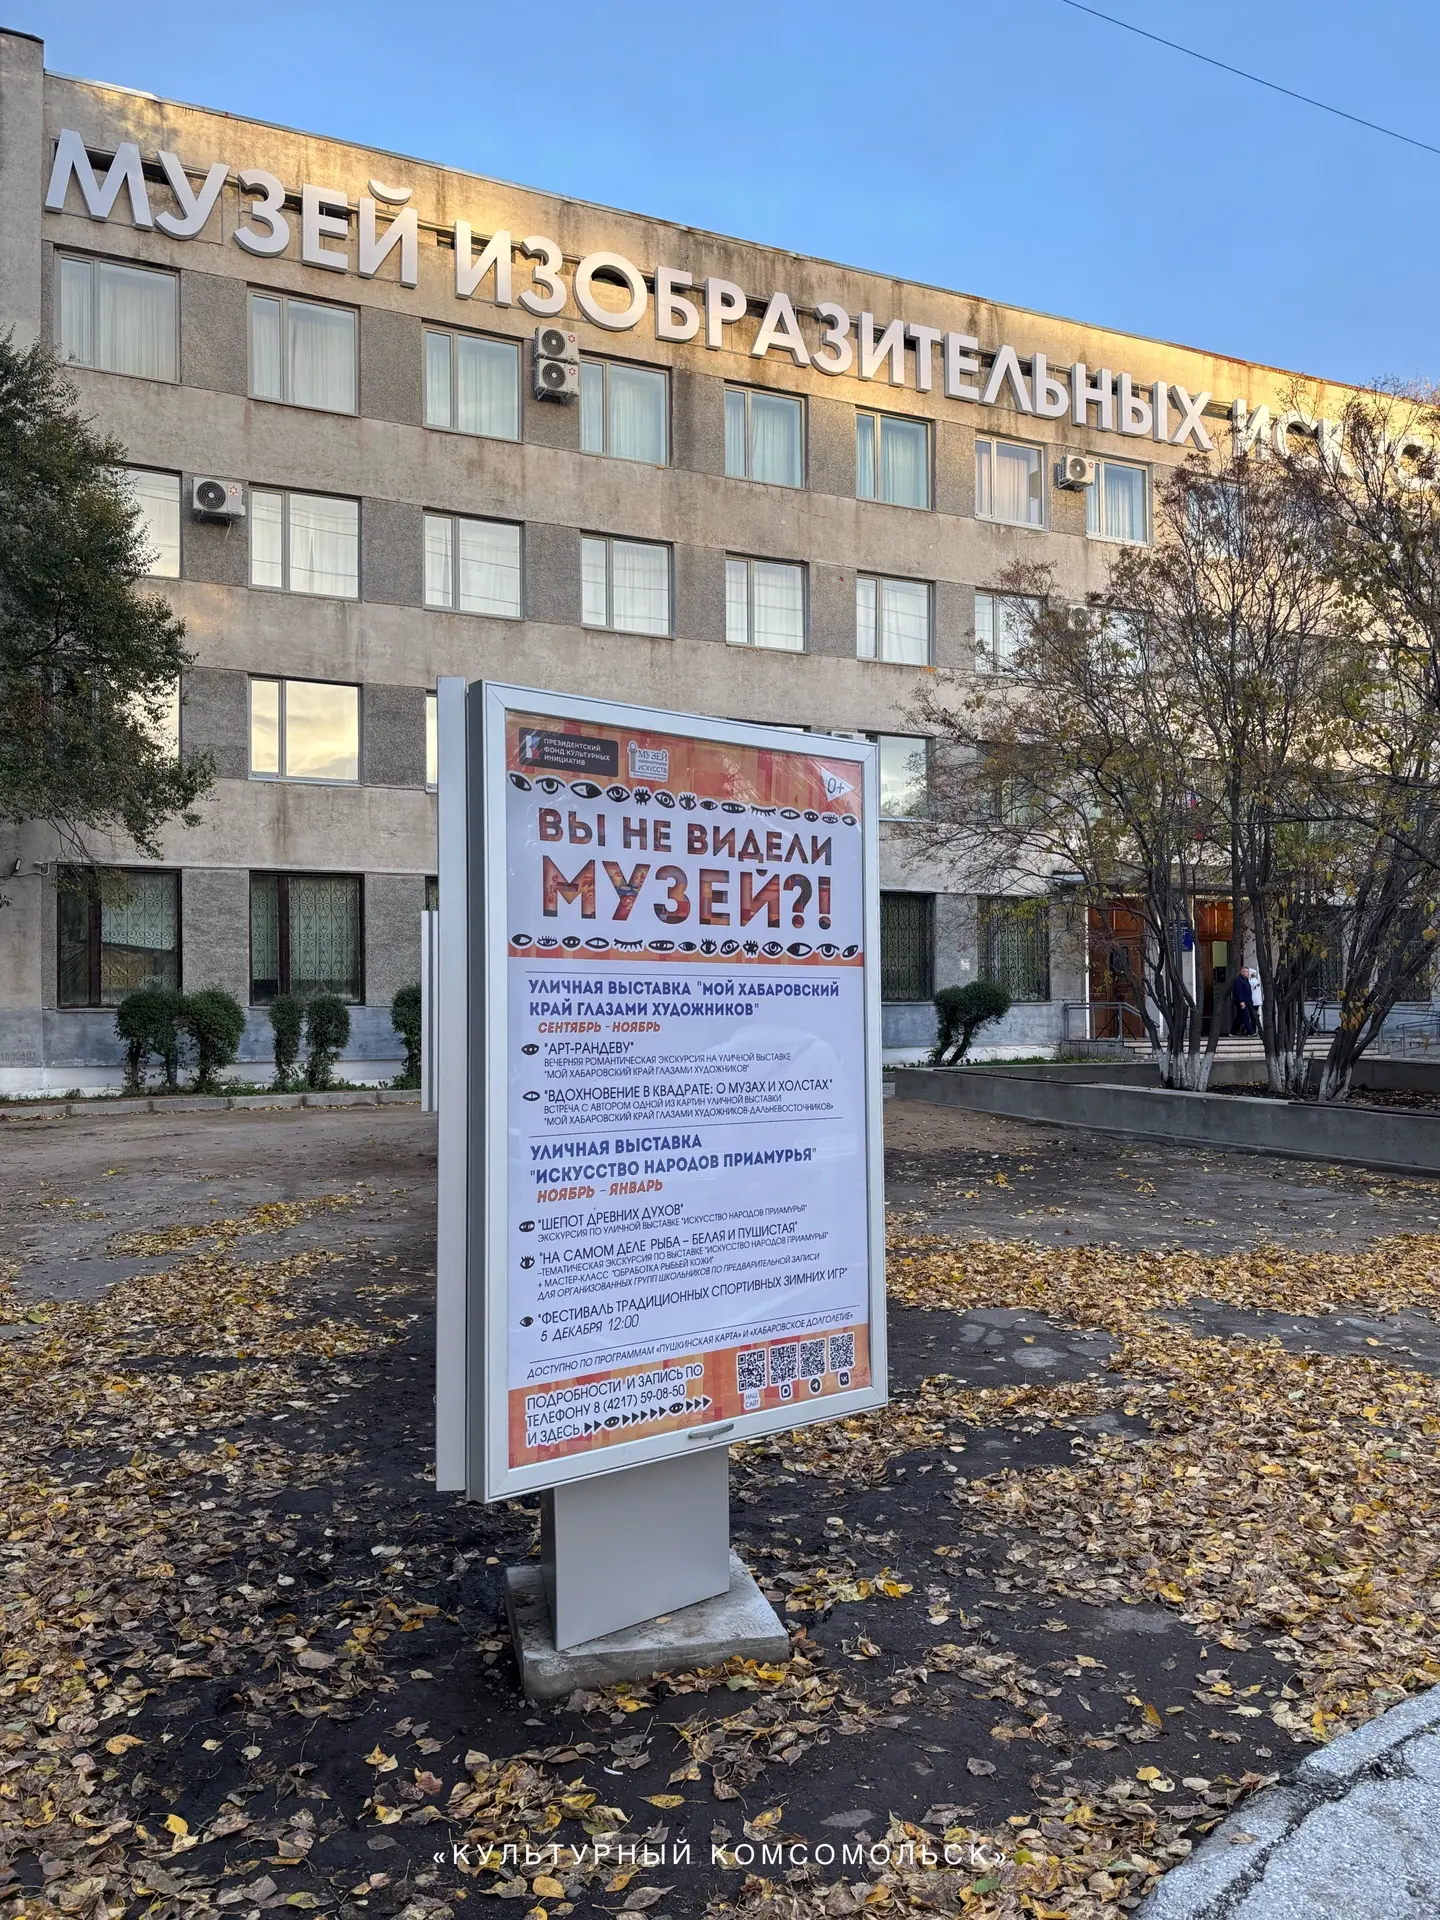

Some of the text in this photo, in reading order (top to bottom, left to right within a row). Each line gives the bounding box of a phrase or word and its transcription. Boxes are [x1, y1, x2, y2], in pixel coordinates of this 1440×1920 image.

[45, 128, 418, 289] МУЗЕЙ
[454, 220, 1213, 452] ИЗОБРАЗИТЕЛЬНЫХ
[544, 738, 601, 752] ПРЕЗИДЕНТСКИЙ
[544, 746, 610, 761] ФОНД КУЛЬТУРНЫХ
[638, 749, 668, 762] МУЗЕЙ
[544, 754, 586, 766] ИНИЦИАТИВ
[827, 777, 845, 794] 0+
[538, 807, 832, 865] ВЫ НЕ ВИДЕЛИ
[543, 855, 831, 930] МУЗЕЙ?!
[528, 979, 839, 997] УЛИЧНАЯ ВЫСТАВКА "МОЙ ХАБАРОВСКИЙ
[530, 998, 759, 1017] КРАЙ ГЛАЗАМИ ХУДОЖНИКОВ"
[538, 1022, 602, 1033] СЕНТЯБРЬ
[612, 1021, 661, 1032] НОЯБРЬ
[544, 1041, 634, 1056] "АРТ-РАНДЕВУ"
[544, 1052, 791, 1067] ВЕЧЕРНЯЯ РОМАНТИЧЕСКАЯ ЭКСКУРСИЯ НА УЛИЧНОЙ ВЫСТАВКЕ
[544, 1064, 749, 1078] "МОЙ ХАБАРОВСКИЙ КРАЙ ГЛАЗАМИ ХУДОЖНИКОВ"
[544, 1078, 833, 1103] "ВДОХНОВЕНИЕ В КВАДРАТЕ: О МУЗАХ И ХОЛСТАХ"
[544, 1094, 782, 1114] ВСТРЕЧА С АВТОРОМ ОДНОЙ ИЗ КАРТИН УЛИЧНОЙ ВЫСТАВКИ
[544, 1102, 834, 1126] "МОЙ ХАБАРОВСКИЙ КРАЙ ГЛАЗАМИ ХУДОЖНИКОВ-ДАЛЬНЕВОСТОЧНИКОВ»
[530, 1134, 702, 1160] УЛИЧНАЯ ВЫСТАВКА
[530, 1148, 816, 1184] "ИСКУССТВО НАРОДОВ ПРИАМУРЬЯ"
[537, 1185, 595, 1203] НОЯБРЬ
[609, 1179, 663, 1196] ЯНВАРЬ
[538, 1204, 684, 1231] "ШЕПОТ ДРЕВНИХ ДУХОВ"
[538, 1204, 808, 1243] ЭКСКУРСИЯ ПО УЛИЧНОЙ ВЫСТАВКЕ "ИСКУССТВО НАРОДОВ ПРИАМУРЬЯ"
[540, 1251, 560, 1264] "НА
[564, 1244, 614, 1262] САМОМ
[617, 1240, 646, 1256] ДЕЛЕ
[650, 1236, 680, 1250] РЫБА
[692, 1230, 726, 1245] БЕЛАЯ
[728, 1229, 736, 1240] И
[738, 1221, 798, 1239] ПУШИСТАЯ"
[606, 1256, 652, 1268] ЭКСКУРСИЯ
[654, 1253, 665, 1262] ПО
[666, 1248, 703, 1260] ВЫСТАВКЕ
[704, 1242, 750, 1254] "ИСКУССТВО
[752, 1237, 786, 1248] НАРОДОВ
[787, 1232, 828, 1244] ПРИАМУРЬЯ"
[537, 1252, 820, 1301] ДЛЯ ОРГАНИЗОВАННЫХ ГРУПП ШКОЛЬНИКОВ ПО ПРЕДВАРИТЕЛЬНОЙ ЗАПИСИ
[544, 1271, 608, 1288] МАСТЕР-КЛАСС
[612, 1265, 659, 1278] "ОБРАБОТКА
[660, 1259, 688, 1270] РЫБЬЕЙ
[690, 1256, 714, 1266] КОЖИ"
[538, 1268, 848, 1324] "ФЕСТИВАЛЬ ТРАДИЦИОННЫХ СПОРТИВНЫХ ЗИМНИХ ИГР"
[540, 1314, 640, 1342] 5 ДЕКАБРЯ 12:00
[527, 1312, 853, 1379] ДОСТУПНО ПО ПРОГРАММАМ «ПУШКИНСКАЯ КАРТА» И «ХАБАРОВСКОЕ ДОЛГОЛЕТИЕ»
[527, 1364, 702, 1410] ПОДРОБНОСТИ И ЗАПИСЬ ПО
[527, 1384, 686, 1427] ТЕЛЕФОНУ 8 (4217) 59-08-50
[528, 1424, 580, 1446] И ЗДЕСЬ
